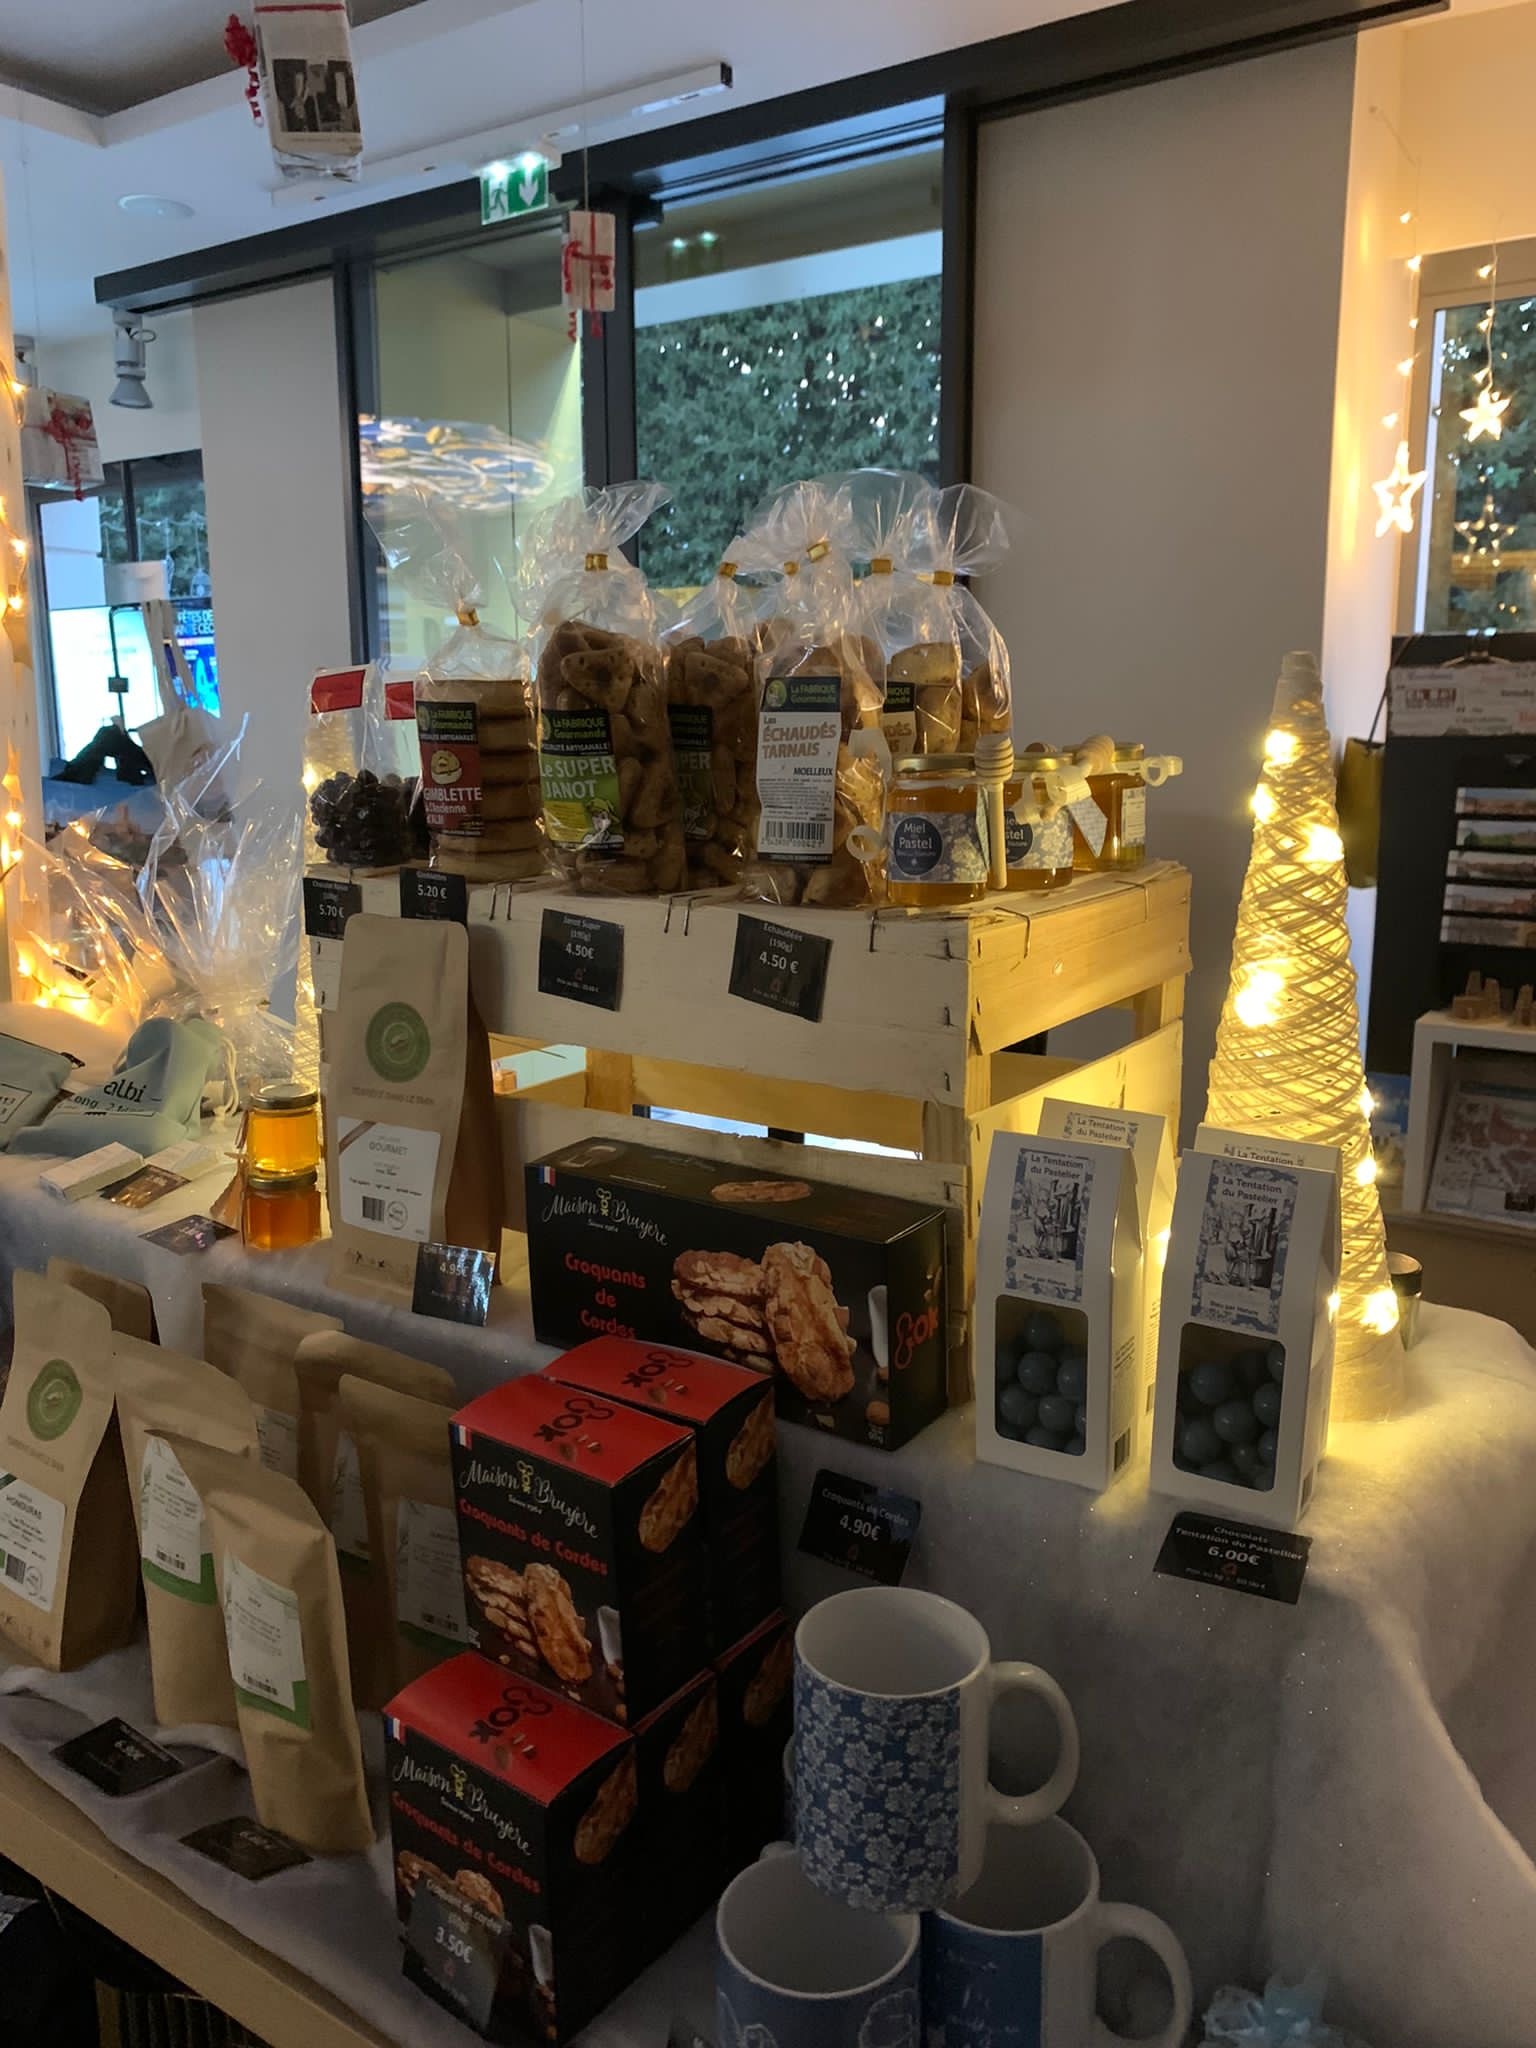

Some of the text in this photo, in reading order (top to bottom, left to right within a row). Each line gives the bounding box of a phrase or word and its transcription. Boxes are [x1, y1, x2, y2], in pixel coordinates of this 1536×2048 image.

[762, 722, 837, 742] ÉCHAUDÉS
[763, 742, 820, 759] TARNAIS
[554, 756, 617, 778] SUPER
[793, 767, 833, 777] MOELLEUX
[546, 779, 598, 800] JANOT
[903, 823, 925, 833] Miel
[898, 837, 932, 848] Pastel
[417, 884, 447, 899] 5.20 €
[319, 904, 336, 917] 5.70
[565, 942, 595, 959] 4.50€
[759, 951, 800, 974] 4.50 €
[103, 1079, 147, 1103] albi
[1077, 1117, 1126, 1133] La Tentation
[1076, 1128, 1122, 1142] du Pastelier
[369, 1141, 408, 1156] GOURMET
[1238, 1150, 1293, 1165] La Tentation
[1031, 1154, 1084, 1169] La Tentation
[1031, 1165, 1080, 1179] du Pastelier
[1222, 1175, 1282, 1194] La Tentation
[1222, 1188, 1279, 1204] du Pastelier
[542, 1194, 669, 1247] Maison Bruyère
[564, 1252, 647, 1289] Croquants
[594, 1288, 617, 1307] de
[580, 1308, 637, 1339] Cordes
[459, 1460, 519, 1488] Maison
[535, 1476, 598, 1539] Bruyère
[458, 1498, 527, 1542] Croquants
[530, 1530, 551, 1552] de
[555, 1540, 608, 1577] Cordes
[839, 1514, 881, 1542] 4.90€
[1175, 1527, 1229, 1545] Tentation
[1232, 1539, 1246, 1548] du
[1214, 1526, 1269, 1544] Chocolats
[1208, 1546, 1261, 1566] 6.00€
[392, 1755, 451, 1793] Maison
[464, 1783, 534, 1856] Bruyère
[463, 1836, 483, 1862] de
[487, 1851, 542, 1894] Cordes
[435, 1926, 473, 1964] 3.50€
